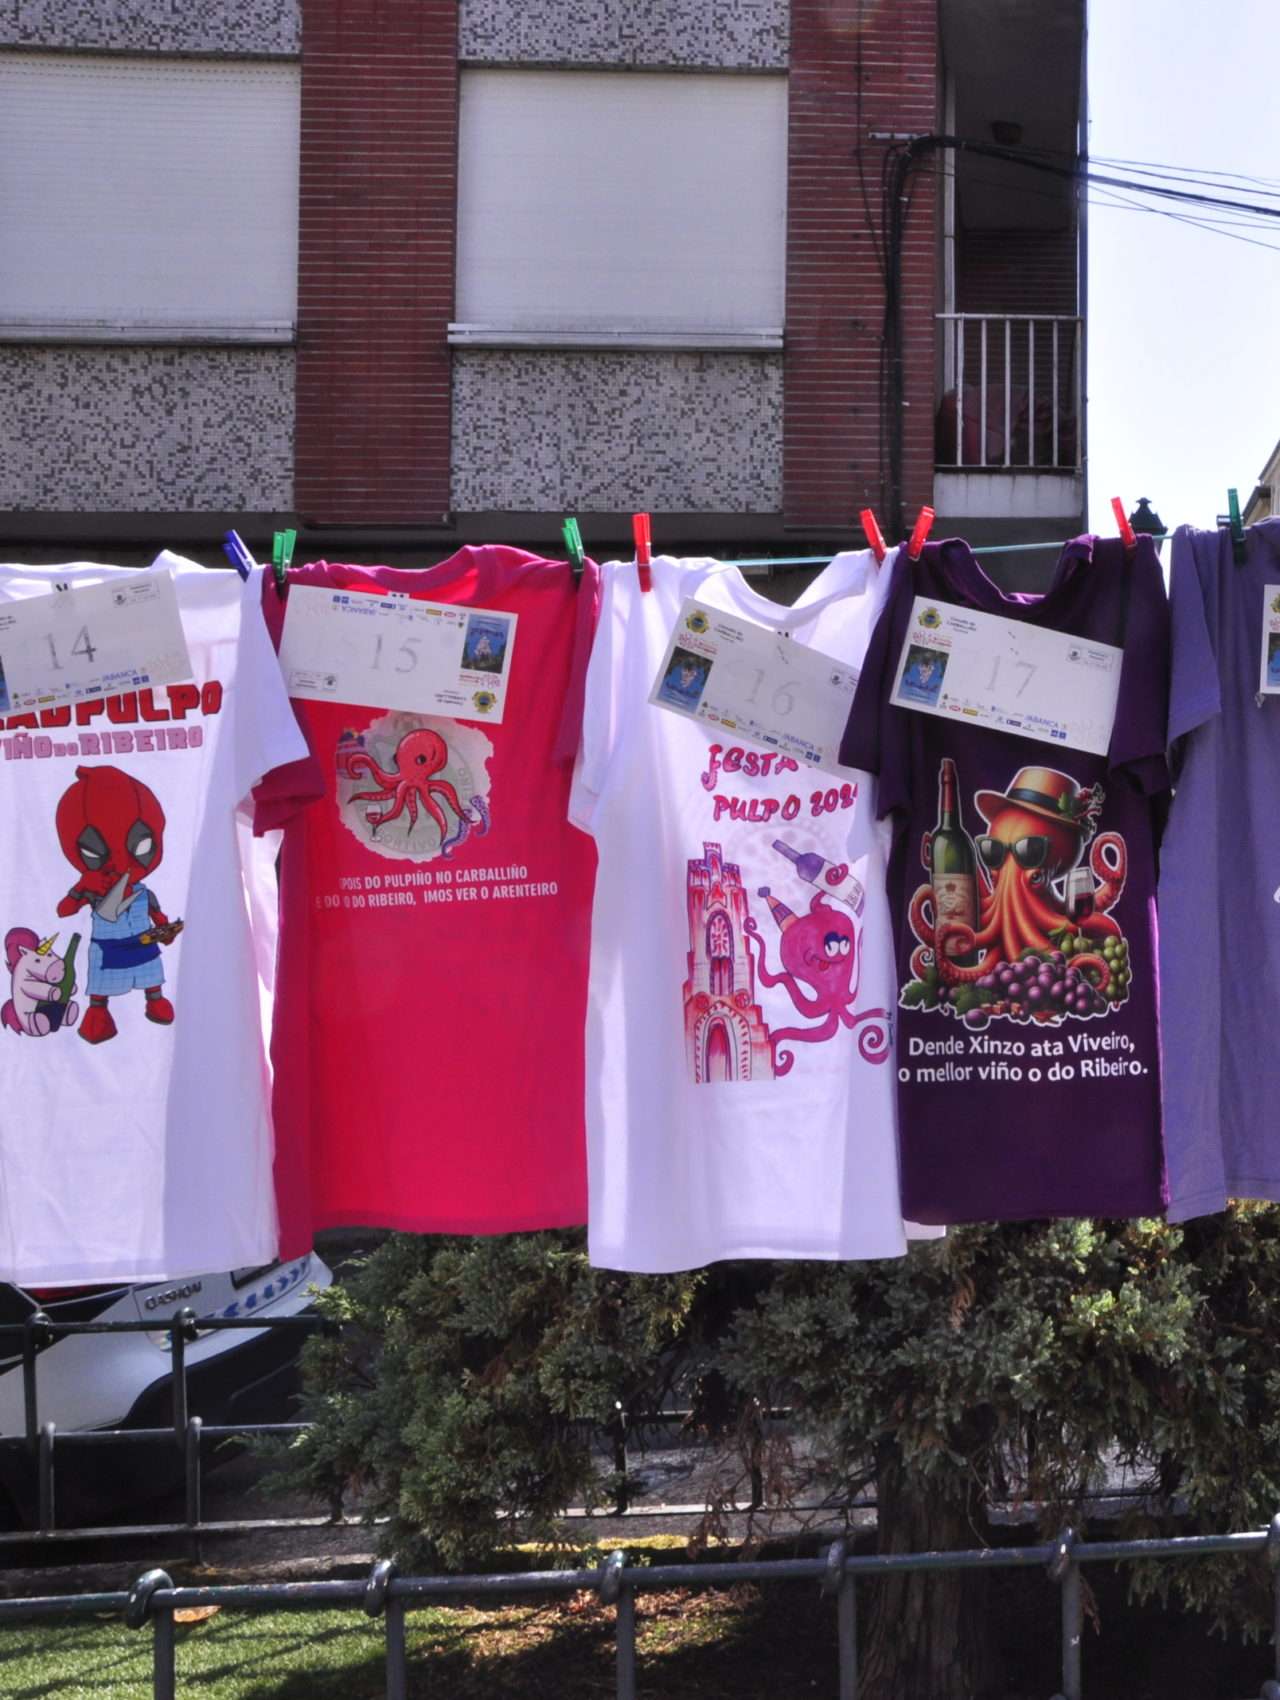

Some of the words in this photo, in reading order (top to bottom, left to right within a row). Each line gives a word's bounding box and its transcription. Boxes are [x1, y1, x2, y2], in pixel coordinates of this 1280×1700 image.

[45, 625, 97, 670] 14
[368, 633, 423, 673] 15
[746, 668, 800, 716] 16
[985, 655, 1037, 697] 17
[0, 732, 52, 760] IÑO
[78, 725, 203, 756] RIBEIRO
[713, 794, 802, 823] PULPO
[365, 875, 381, 889] DO
[384, 870, 432, 888] PULPIÑO
[435, 871, 452, 884] NO
[456, 864, 528, 882] CARBALLIÑO
[424, 889, 453, 904] IMOS
[455, 887, 477, 901] VER
[480, 886, 489, 900] O
[492, 881, 558, 899] ARENTEIRO
[908, 1037, 965, 1056] Dende
[969, 1035, 1025, 1056] Xinzo
[1030, 1040, 1064, 1057] ata
[1068, 1031, 1135, 1053] Viveiro,
[898, 1067, 910, 1082] o
[916, 1062, 974, 1082] mellor
[978, 1061, 1023, 1081] viño
[1028, 1068, 1042, 1082] o
[1047, 1062, 1075, 1081] do
[1081, 1057, 1149, 1078] Ribeiro.
